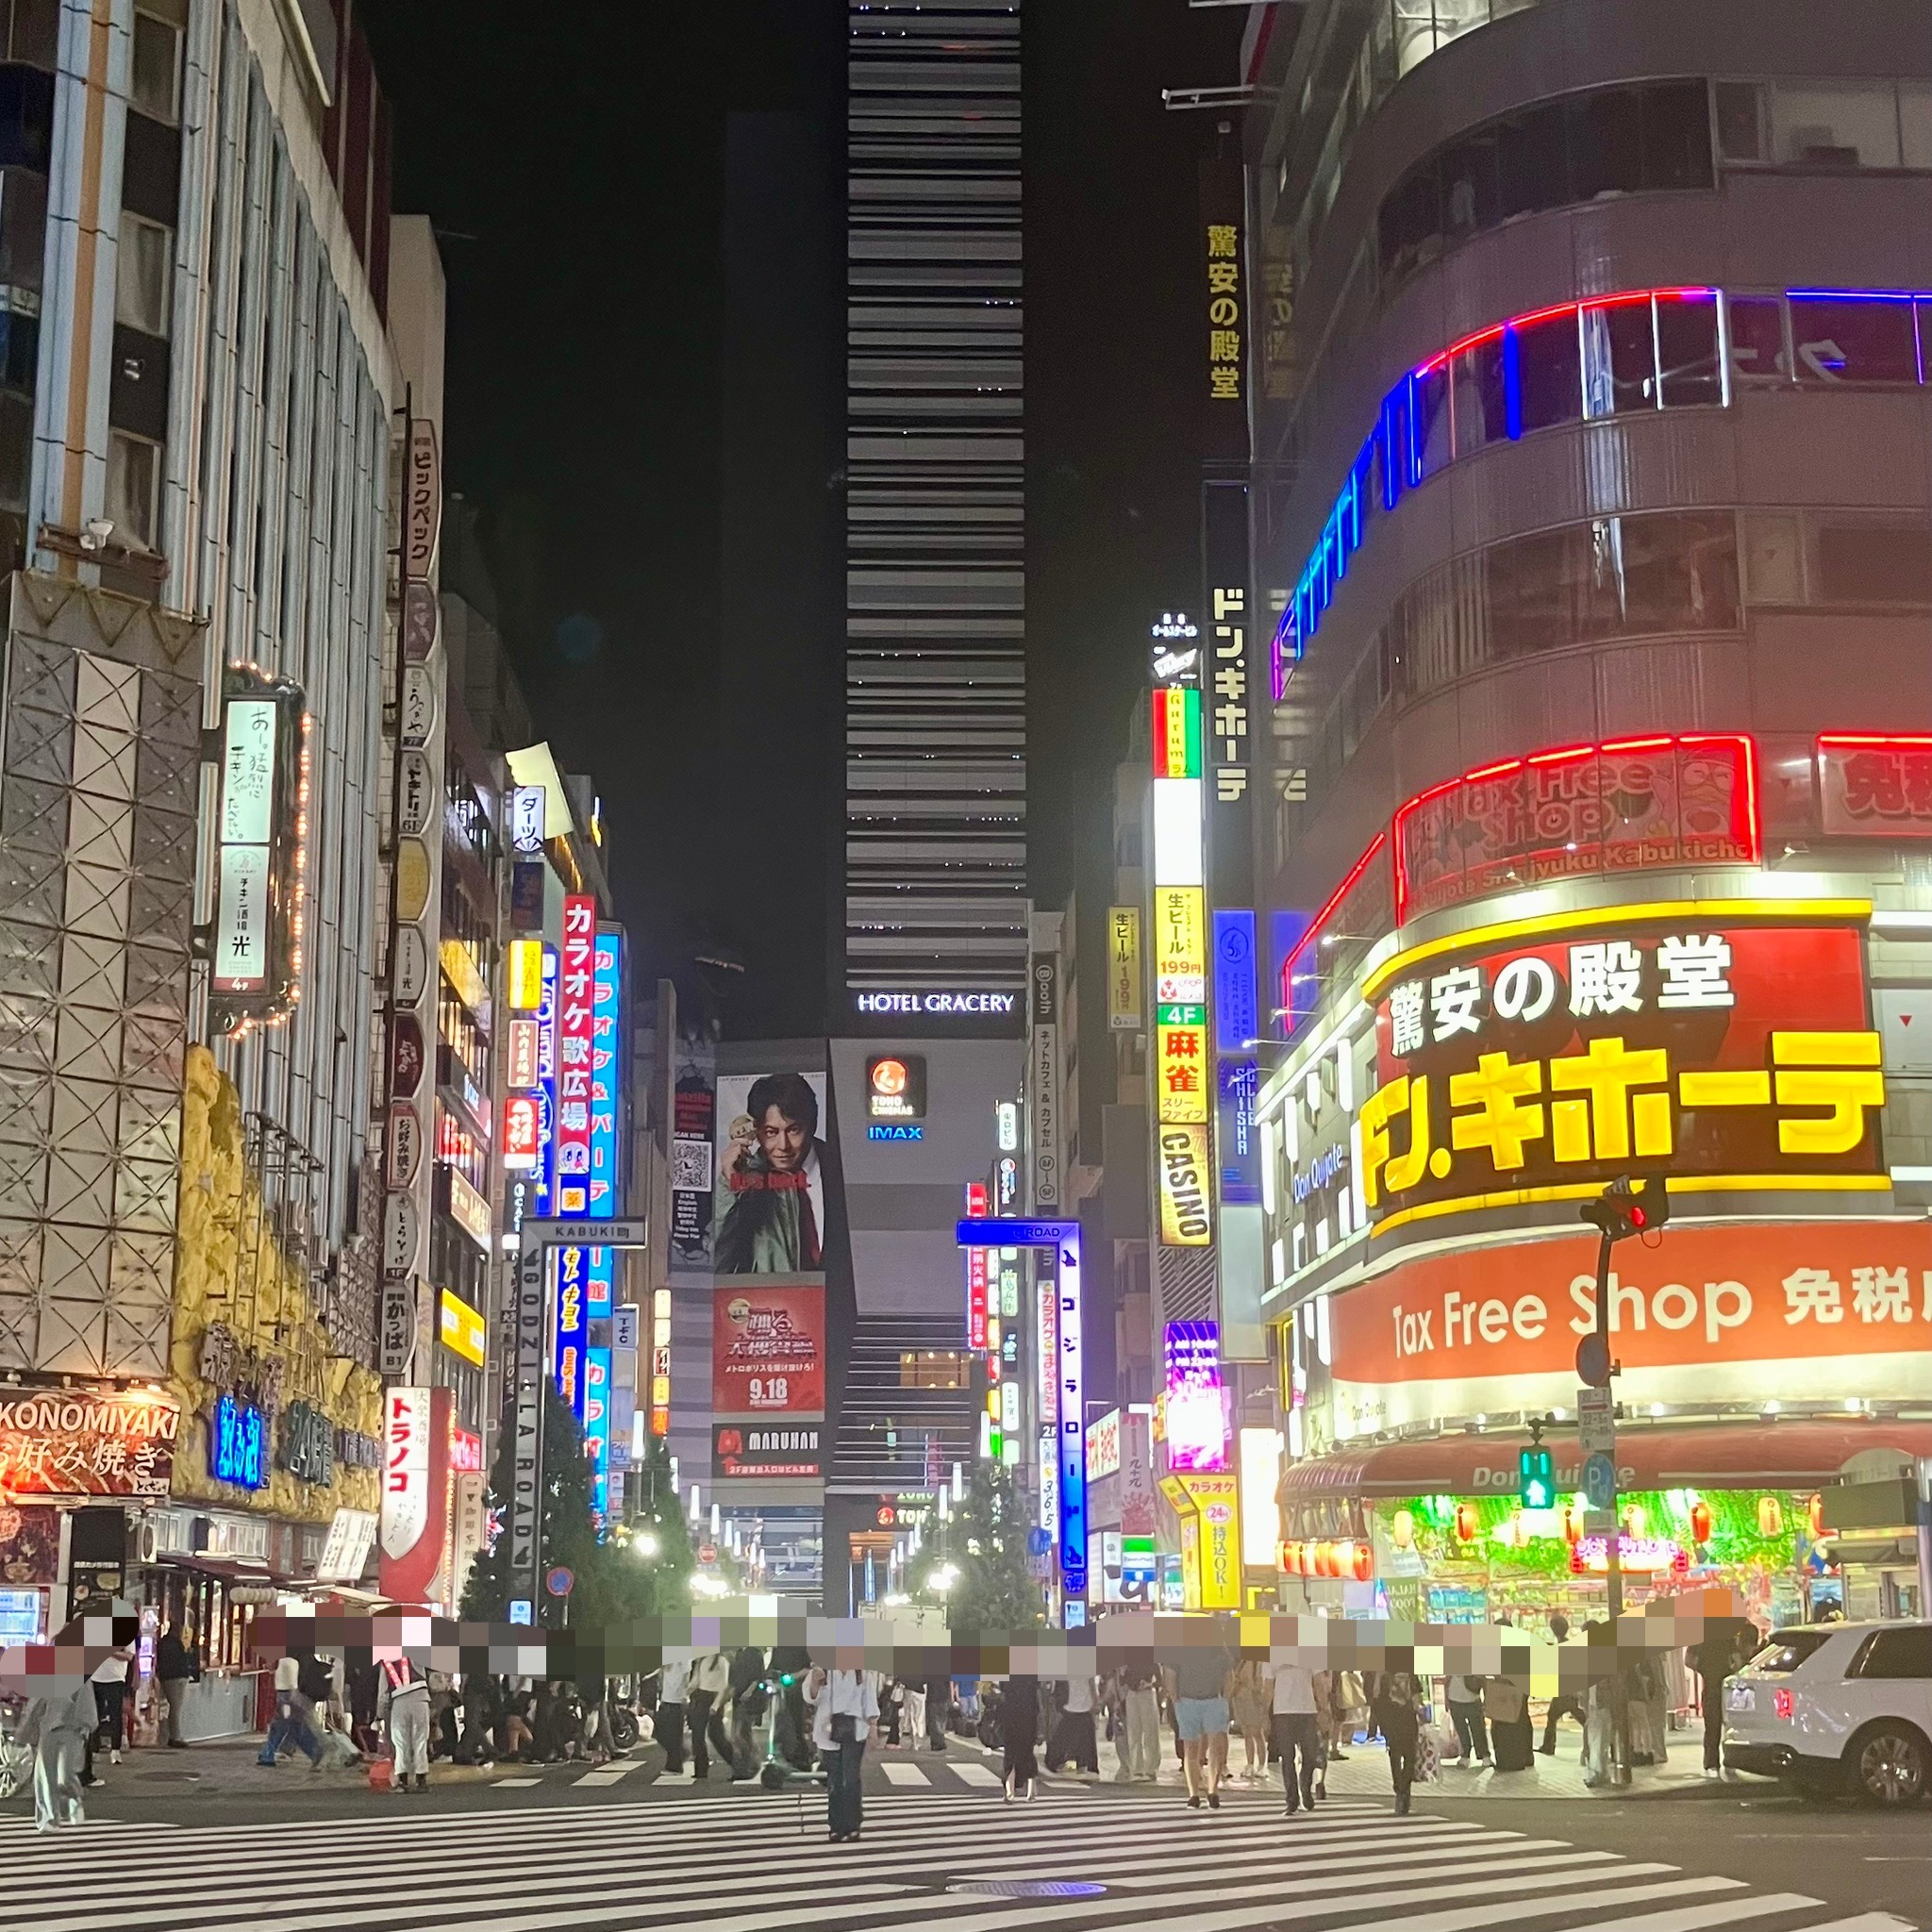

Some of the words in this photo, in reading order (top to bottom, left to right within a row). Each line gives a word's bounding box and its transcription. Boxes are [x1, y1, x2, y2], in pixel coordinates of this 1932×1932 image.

[1208, 225, 1240, 398] 驚安の殿堂
[522, 797, 538, 840] ダーツ
[1115, 913, 1129, 963] 生ビール
[1168, 893, 1184, 954] 生ビール
[232, 935, 251, 957] 光
[1160, 961, 1201, 974] 199円
[858, 993, 923, 1012] HOTEL
[924, 993, 1015, 1012] GRACERY
[1167, 1008, 1196, 1024] 4F
[1389, 934, 1737, 1058] 驚安の殿堂
[562, 903, 592, 1131] カラオケ歌広場
[1041, 1031, 1050, 1088] ネットカフェ
[1165, 1030, 1199, 1092] 麻雀
[1041, 1093, 1050, 1104] &
[1163, 1097, 1194, 1108] スリー
[868, 1126, 924, 1141] IMAX
[1041, 1108, 1050, 1148] カプセル
[1162, 1132, 1208, 1237] CASINO
[1294, 1174, 1310, 1204] Don
[555, 1226, 630, 1239] KABUKI町
[1025, 1227, 1060, 1238] ROAD
[1393, 1304, 1434, 1358] Tax
[1443, 1291, 1547, 1348] Free
[1570, 1272, 1753, 1342] Shop
[1782, 1266, 1932, 1324] 免税
[386, 1357, 403, 1366] B1
[518, 1273, 540, 1438] GODZILLA
[749, 1378, 788, 1400] 9.18
[1062, 1297, 1081, 1519] ゴジラロード
[388, 1397, 412, 1492] トラノコ
[749, 1432, 819, 1450] MARUHAN
[515, 1457, 535, 1539] ROAD
[1190, 1481, 1235, 1493] カラオケ
[1473, 1467, 1521, 1488] Don
[1042, 1481, 1055, 1526] 365
